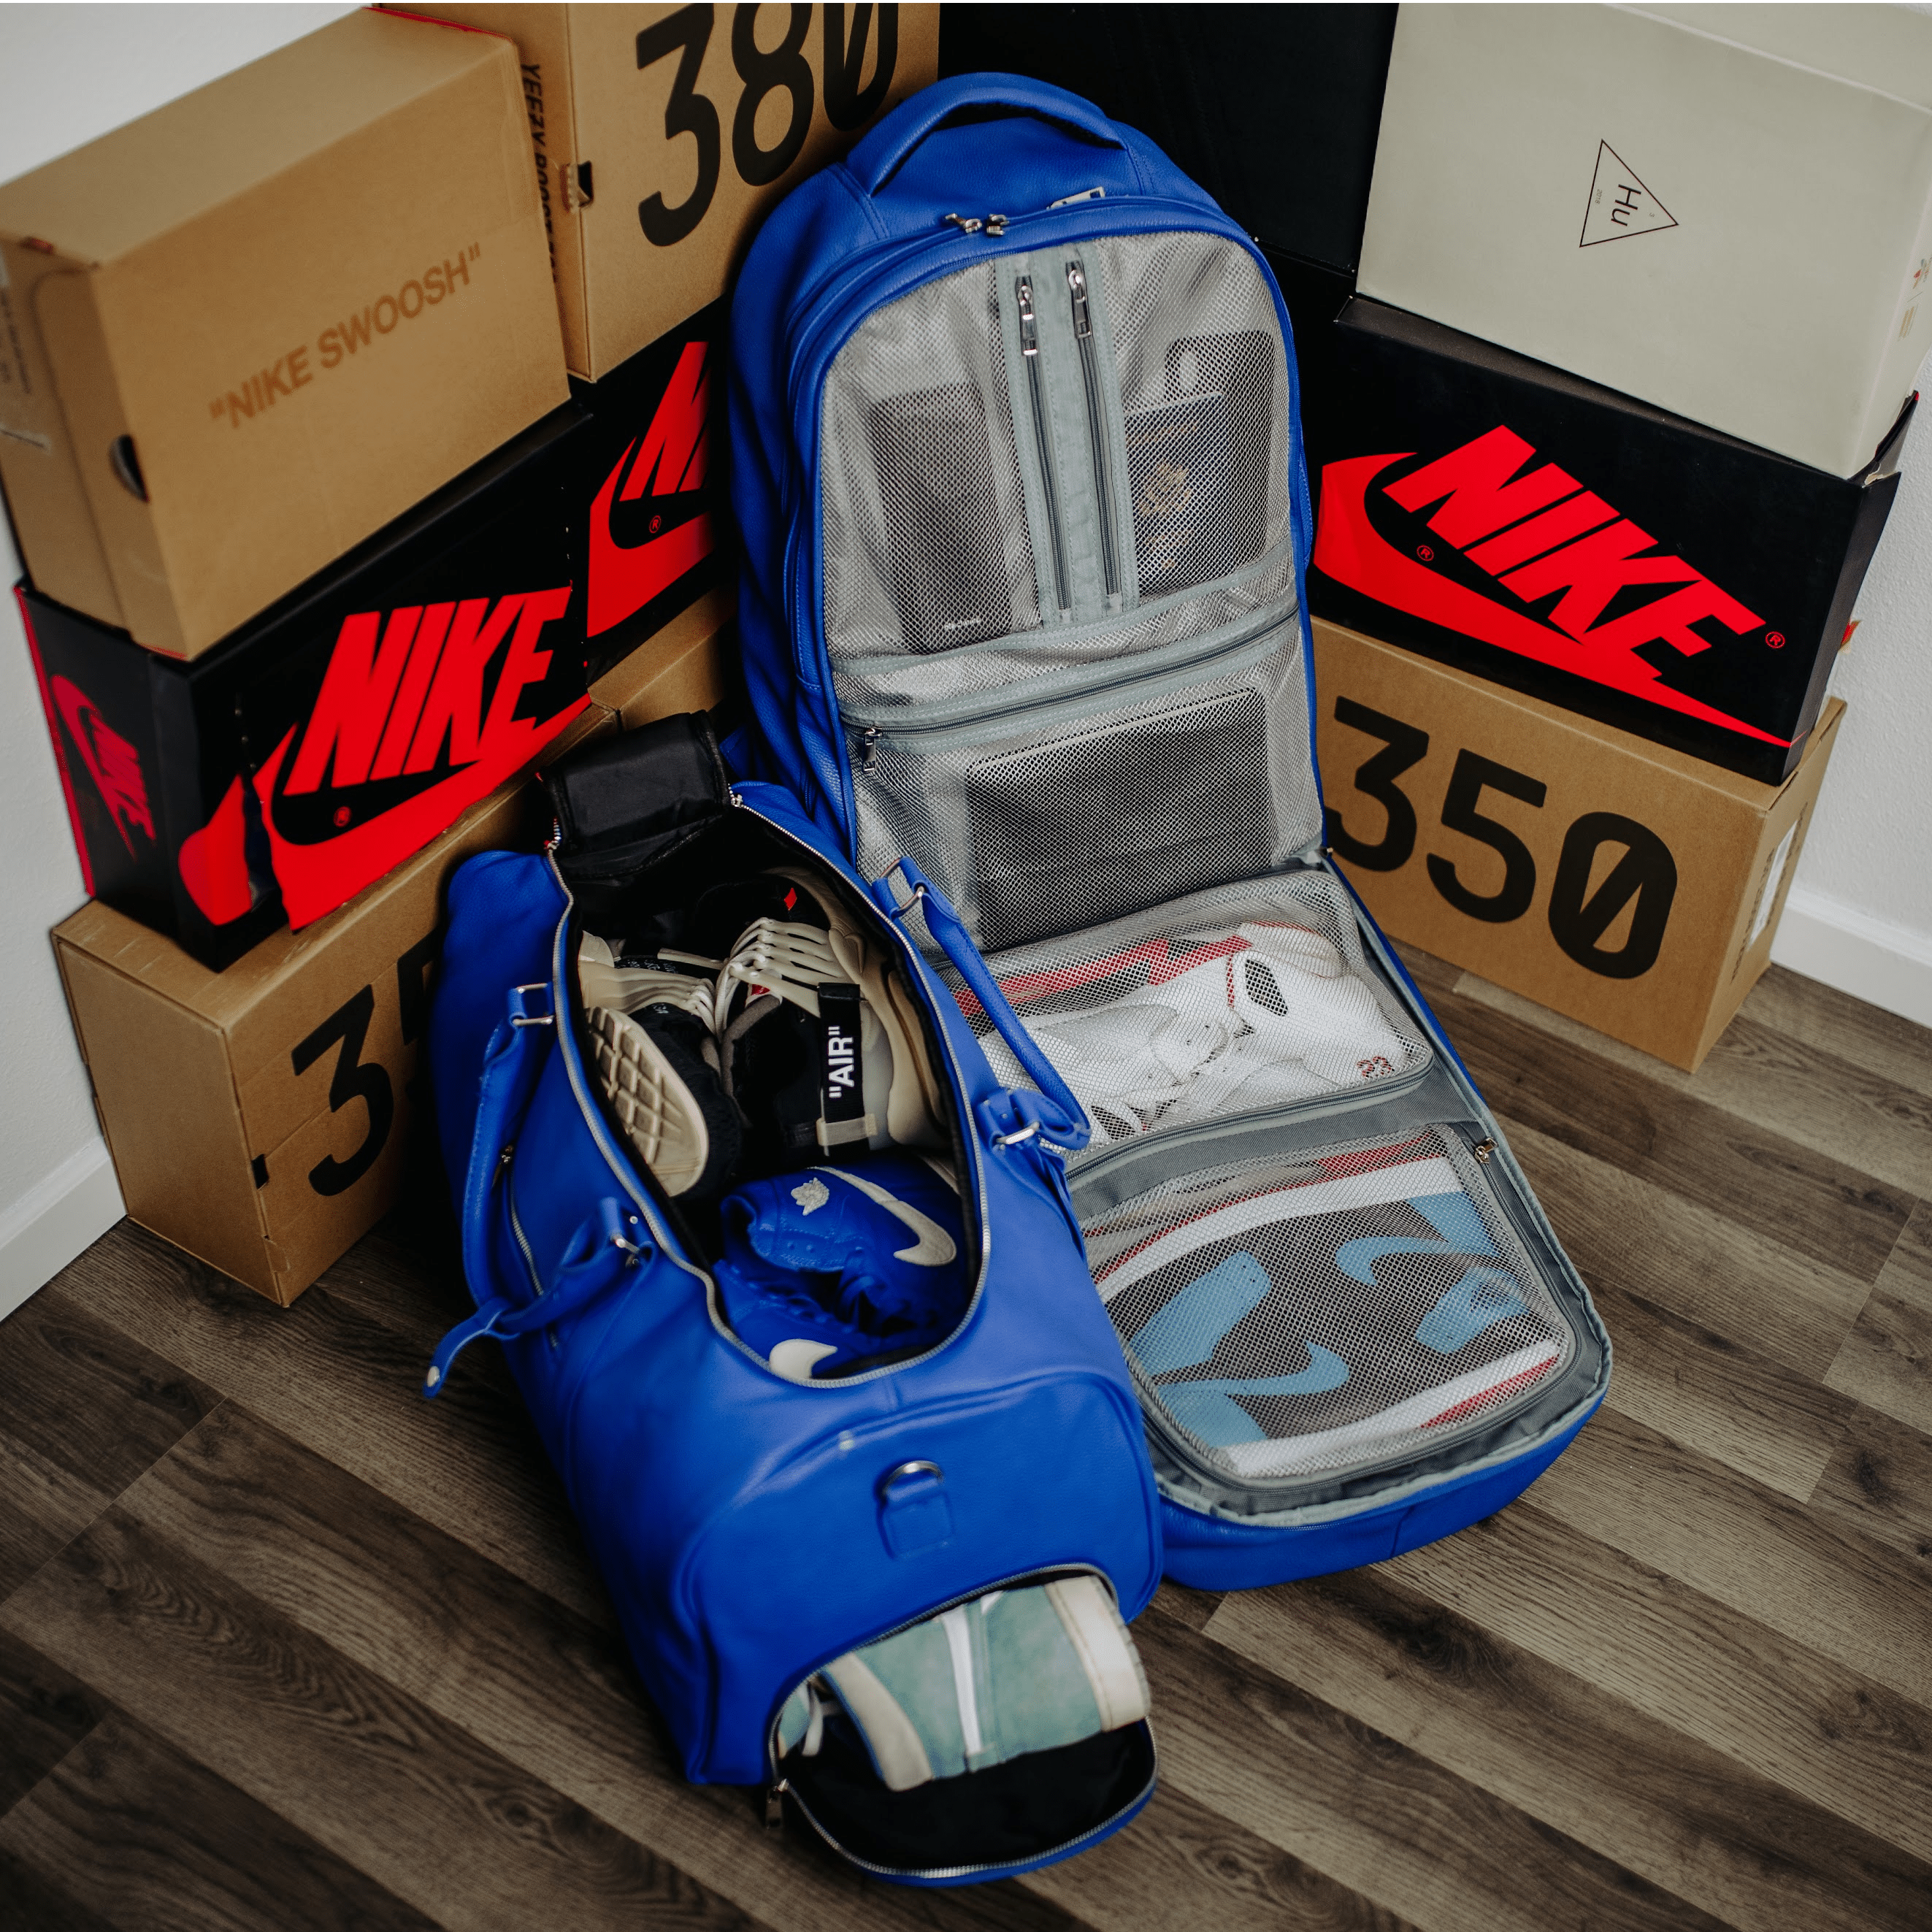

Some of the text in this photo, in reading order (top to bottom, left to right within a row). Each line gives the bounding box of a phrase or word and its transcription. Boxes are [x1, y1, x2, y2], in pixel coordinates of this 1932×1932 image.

[636, 3, 899, 247] 380
[1595, 188, 1603, 204] 2018
[1611, 184, 1641, 226] Hu
[1381, 424, 1767, 680] NIKE
[283, 586, 572, 796] NIKE
[1325, 695, 1678, 979] 350
[828, 1026, 854, 1098] "AIR"
[1356, 1055, 1392, 1078] 23
